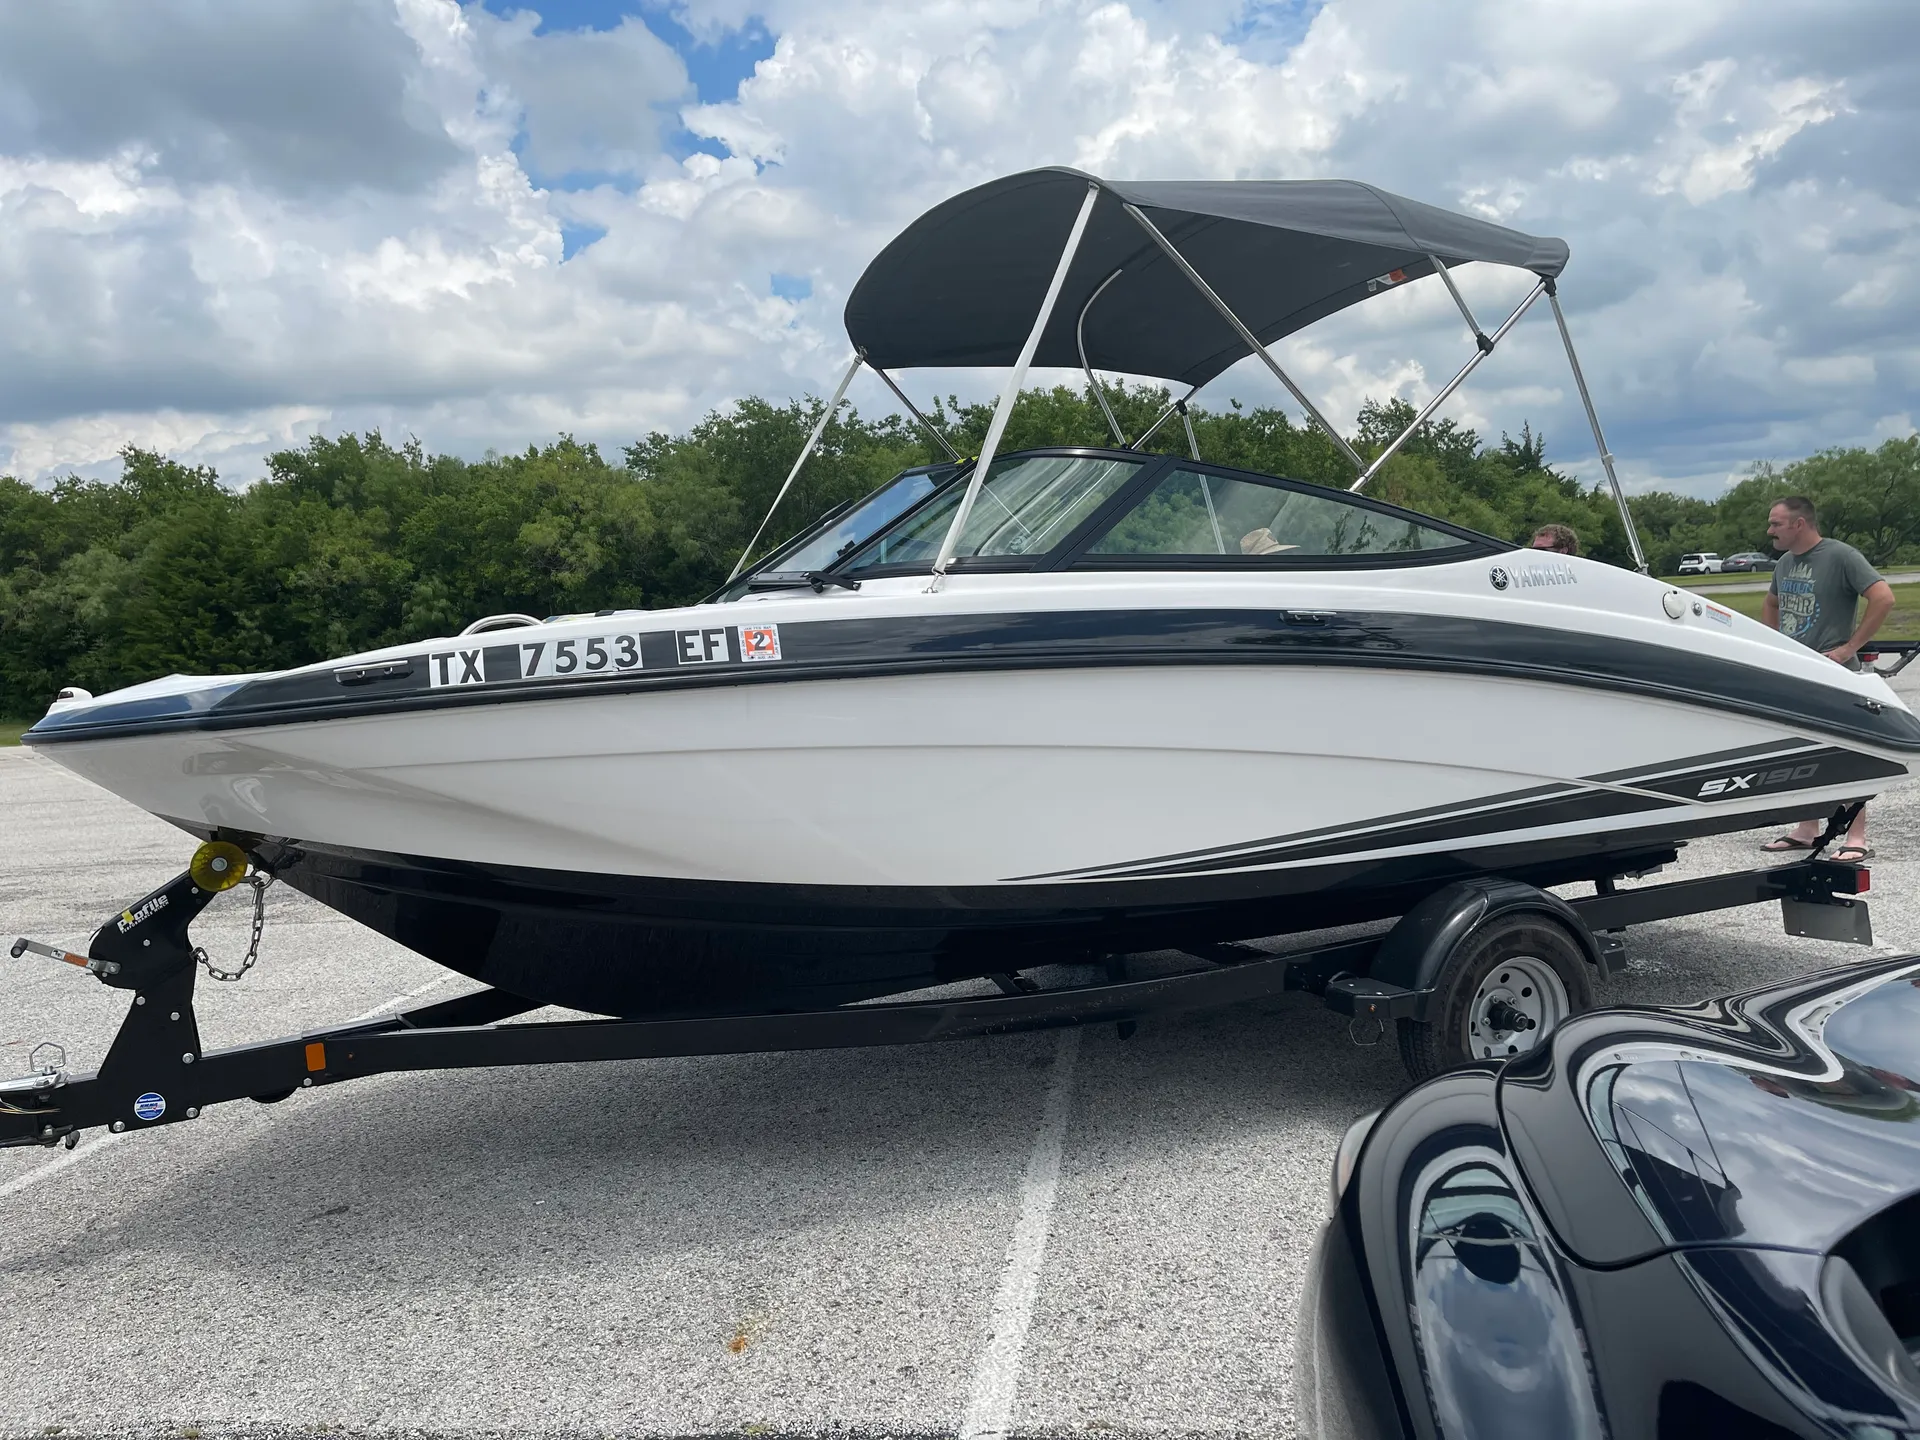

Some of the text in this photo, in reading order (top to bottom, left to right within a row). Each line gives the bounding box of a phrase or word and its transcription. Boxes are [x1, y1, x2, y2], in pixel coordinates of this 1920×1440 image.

[1507, 563, 1577, 588] YAMAHA
[1779, 593, 1813, 615] BEAR
[753, 631, 766, 650] 2
[431, 628, 725, 685] TX 7553 EF
[1697, 763, 1820, 797] SX190
